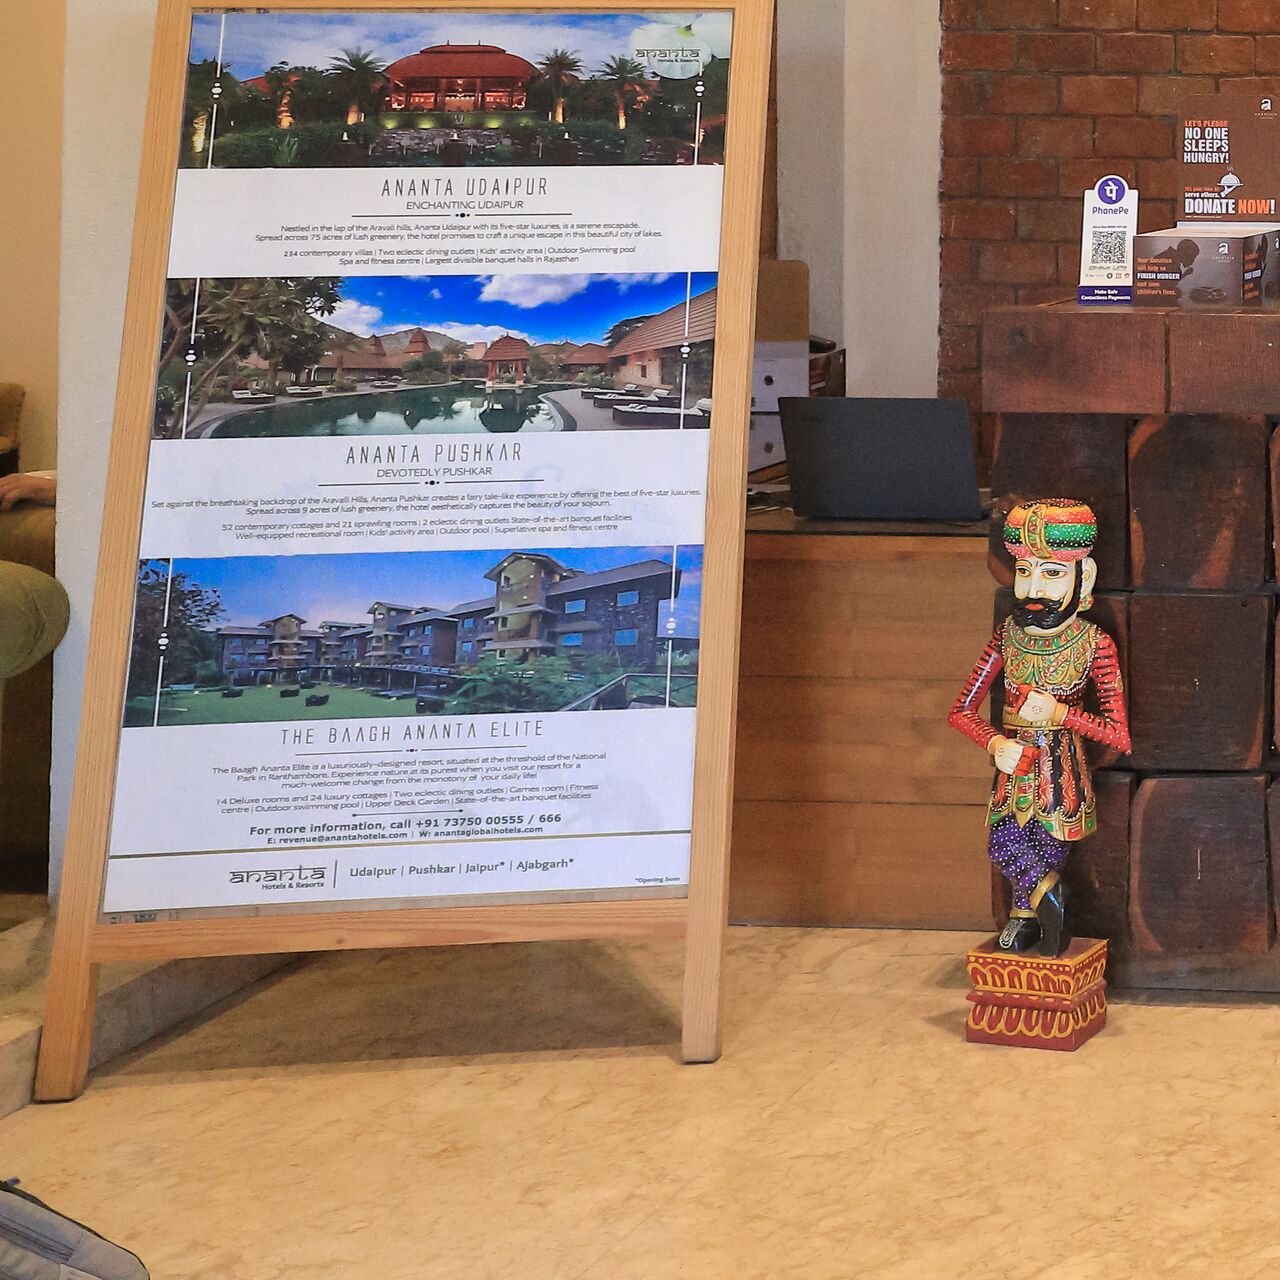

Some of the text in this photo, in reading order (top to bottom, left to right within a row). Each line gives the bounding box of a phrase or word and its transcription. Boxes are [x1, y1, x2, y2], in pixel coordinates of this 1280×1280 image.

[636, 48, 700, 58] ananta
[1185, 128, 1228, 139] NO ONE
[1184, 140, 1229, 152] SLEEPS
[1184, 153, 1229, 163] HUNGRY!
[381, 178, 547, 196] ANANTA UDAIPUR
[406, 201, 524, 210] ENCHANTING UDAIPUR
[1092, 206, 1129, 215] PhonePe
[1185, 199, 1275, 214] DONATE NOW!
[346, 443, 521, 464] ANANTA PUSHKAR
[376, 467, 492, 477] DEVOTEDLY PUSHKAR
[282, 720, 544, 744] THE BAAGH ANANTA ELITE
[250, 826, 271, 835] For
[310, 821, 386, 832] information,
[390, 819, 411, 829] call
[416, 819, 439, 828] +91
[444, 817, 482, 827] 73750
[486, 815, 524, 825] 00555
[539, 814, 561, 823] 666
[279, 832, 408, 844] revenue@anantahotels.com
[434, 826, 543, 838] anantaglobalhotels.com
[229, 865, 327, 883] ananta
[350, 866, 397, 878] Udaipur
[409, 865, 455, 875] Pushkar
